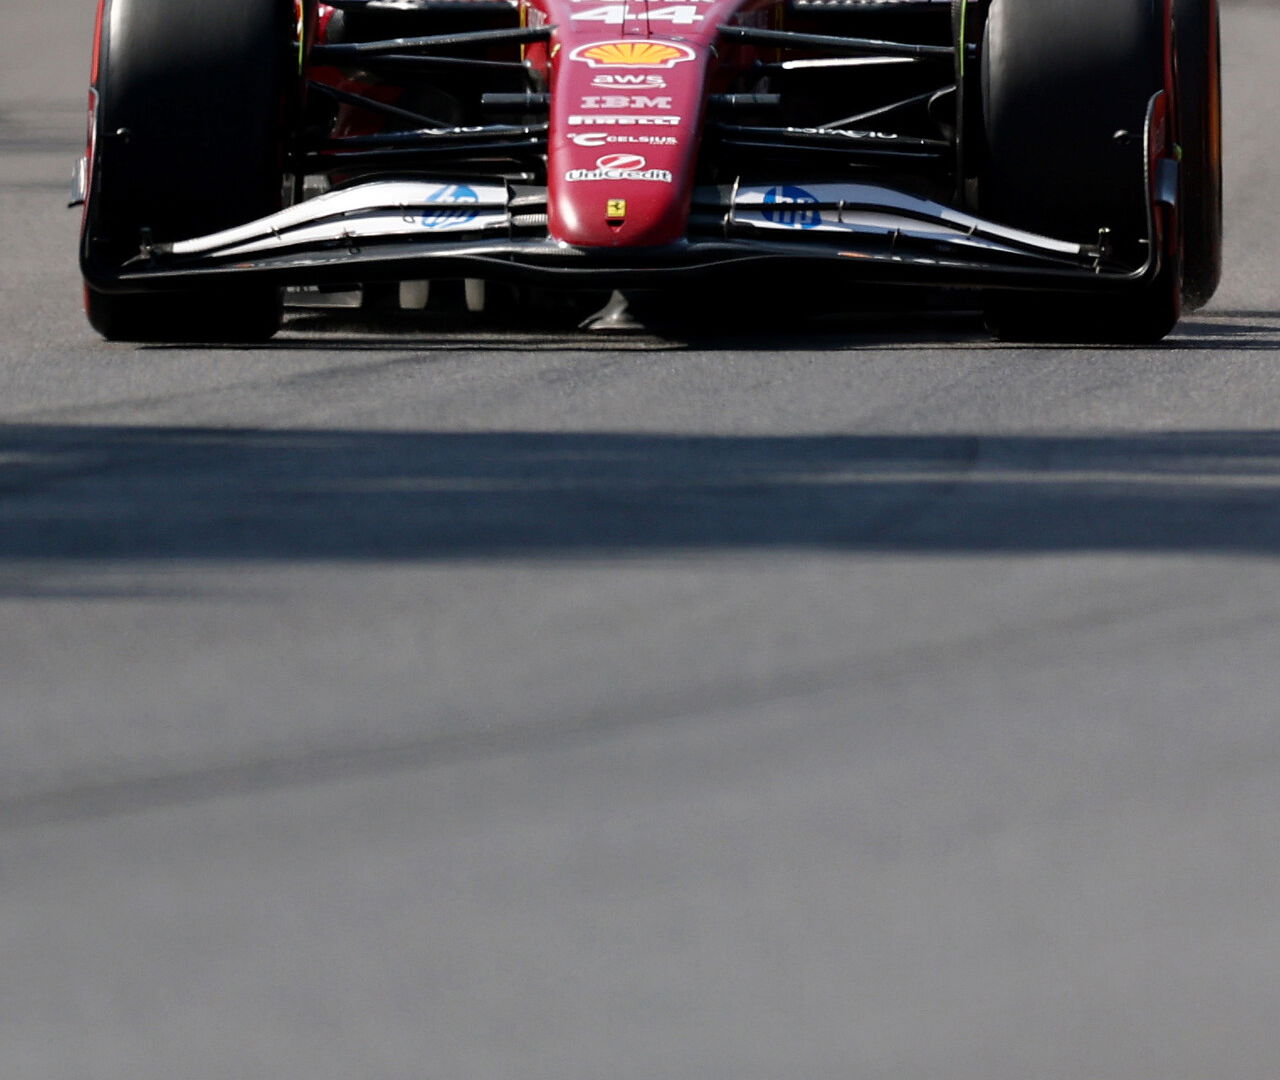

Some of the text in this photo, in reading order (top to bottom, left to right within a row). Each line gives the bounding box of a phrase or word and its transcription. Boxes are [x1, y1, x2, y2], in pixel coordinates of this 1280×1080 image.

[570, 5, 704, 24] 44
[592, 74, 665, 86] aws
[580, 96, 673, 108] IBM
[567, 170, 671, 181] UniCredit
